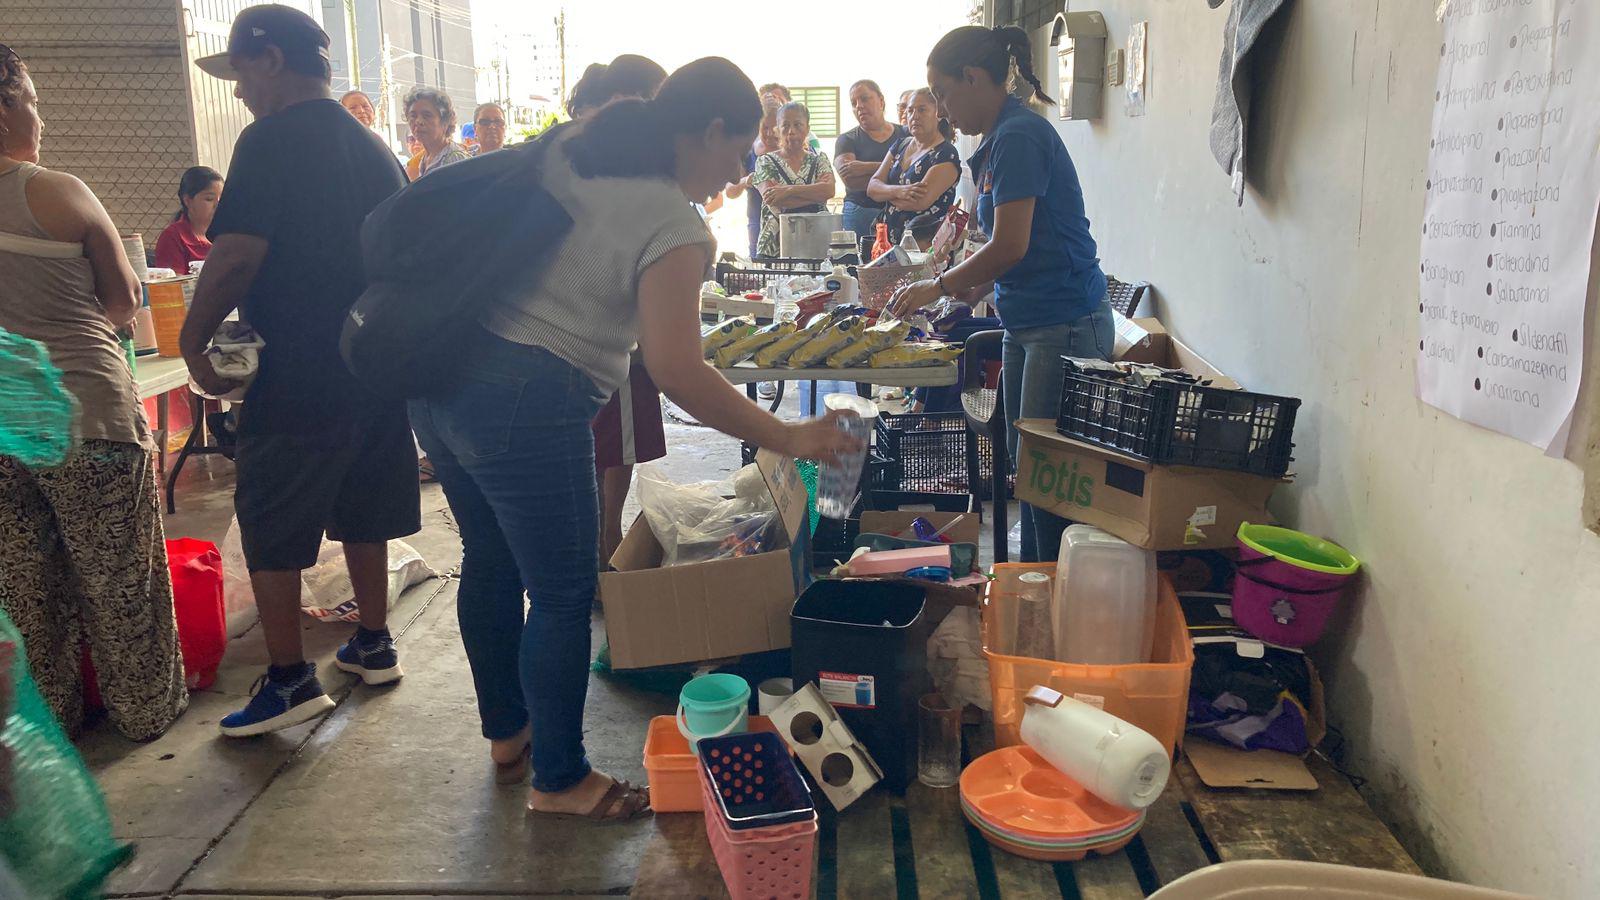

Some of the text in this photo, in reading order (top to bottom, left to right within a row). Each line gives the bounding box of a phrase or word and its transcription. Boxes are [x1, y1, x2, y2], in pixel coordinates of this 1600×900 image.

[1496, 220, 1541, 242] Tiamina
[1496, 278, 1550, 304] Salbutamol
[1518, 322, 1568, 355] Sildenafil
[1485, 346, 1567, 383] Carbamazepina
[1028, 451, 1094, 507] Totis
